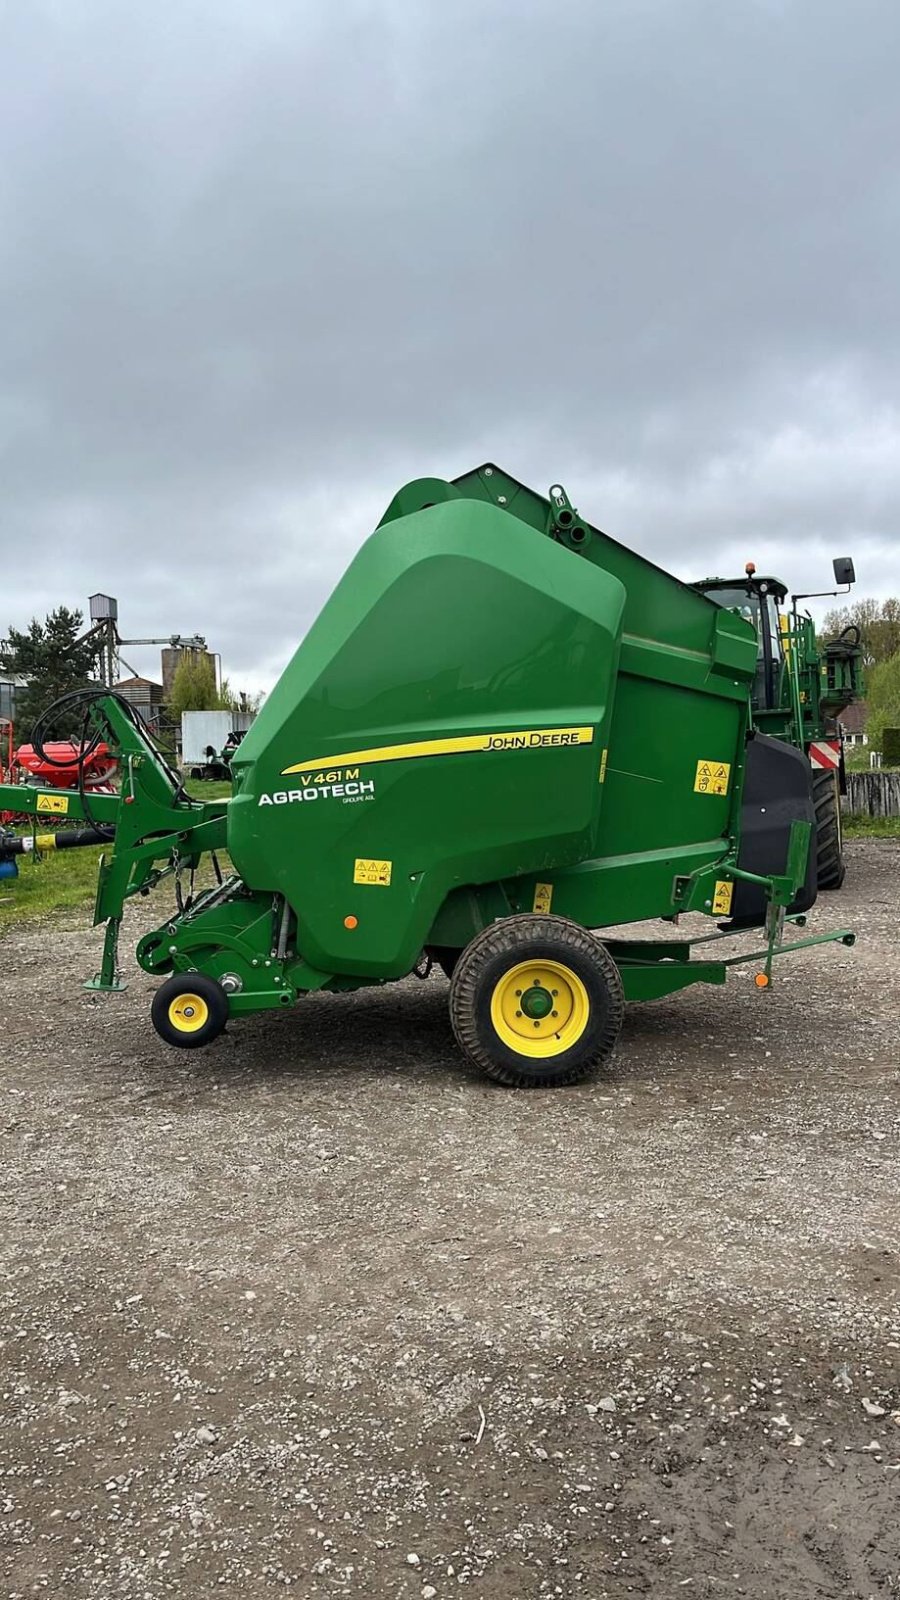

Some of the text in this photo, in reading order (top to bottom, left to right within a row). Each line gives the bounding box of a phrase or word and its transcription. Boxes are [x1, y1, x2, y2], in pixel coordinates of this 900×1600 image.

[483, 732, 580, 750] JOHN DEERE
[301, 768, 360, 786] V 461 M
[258, 780, 375, 807] AGROTECH
